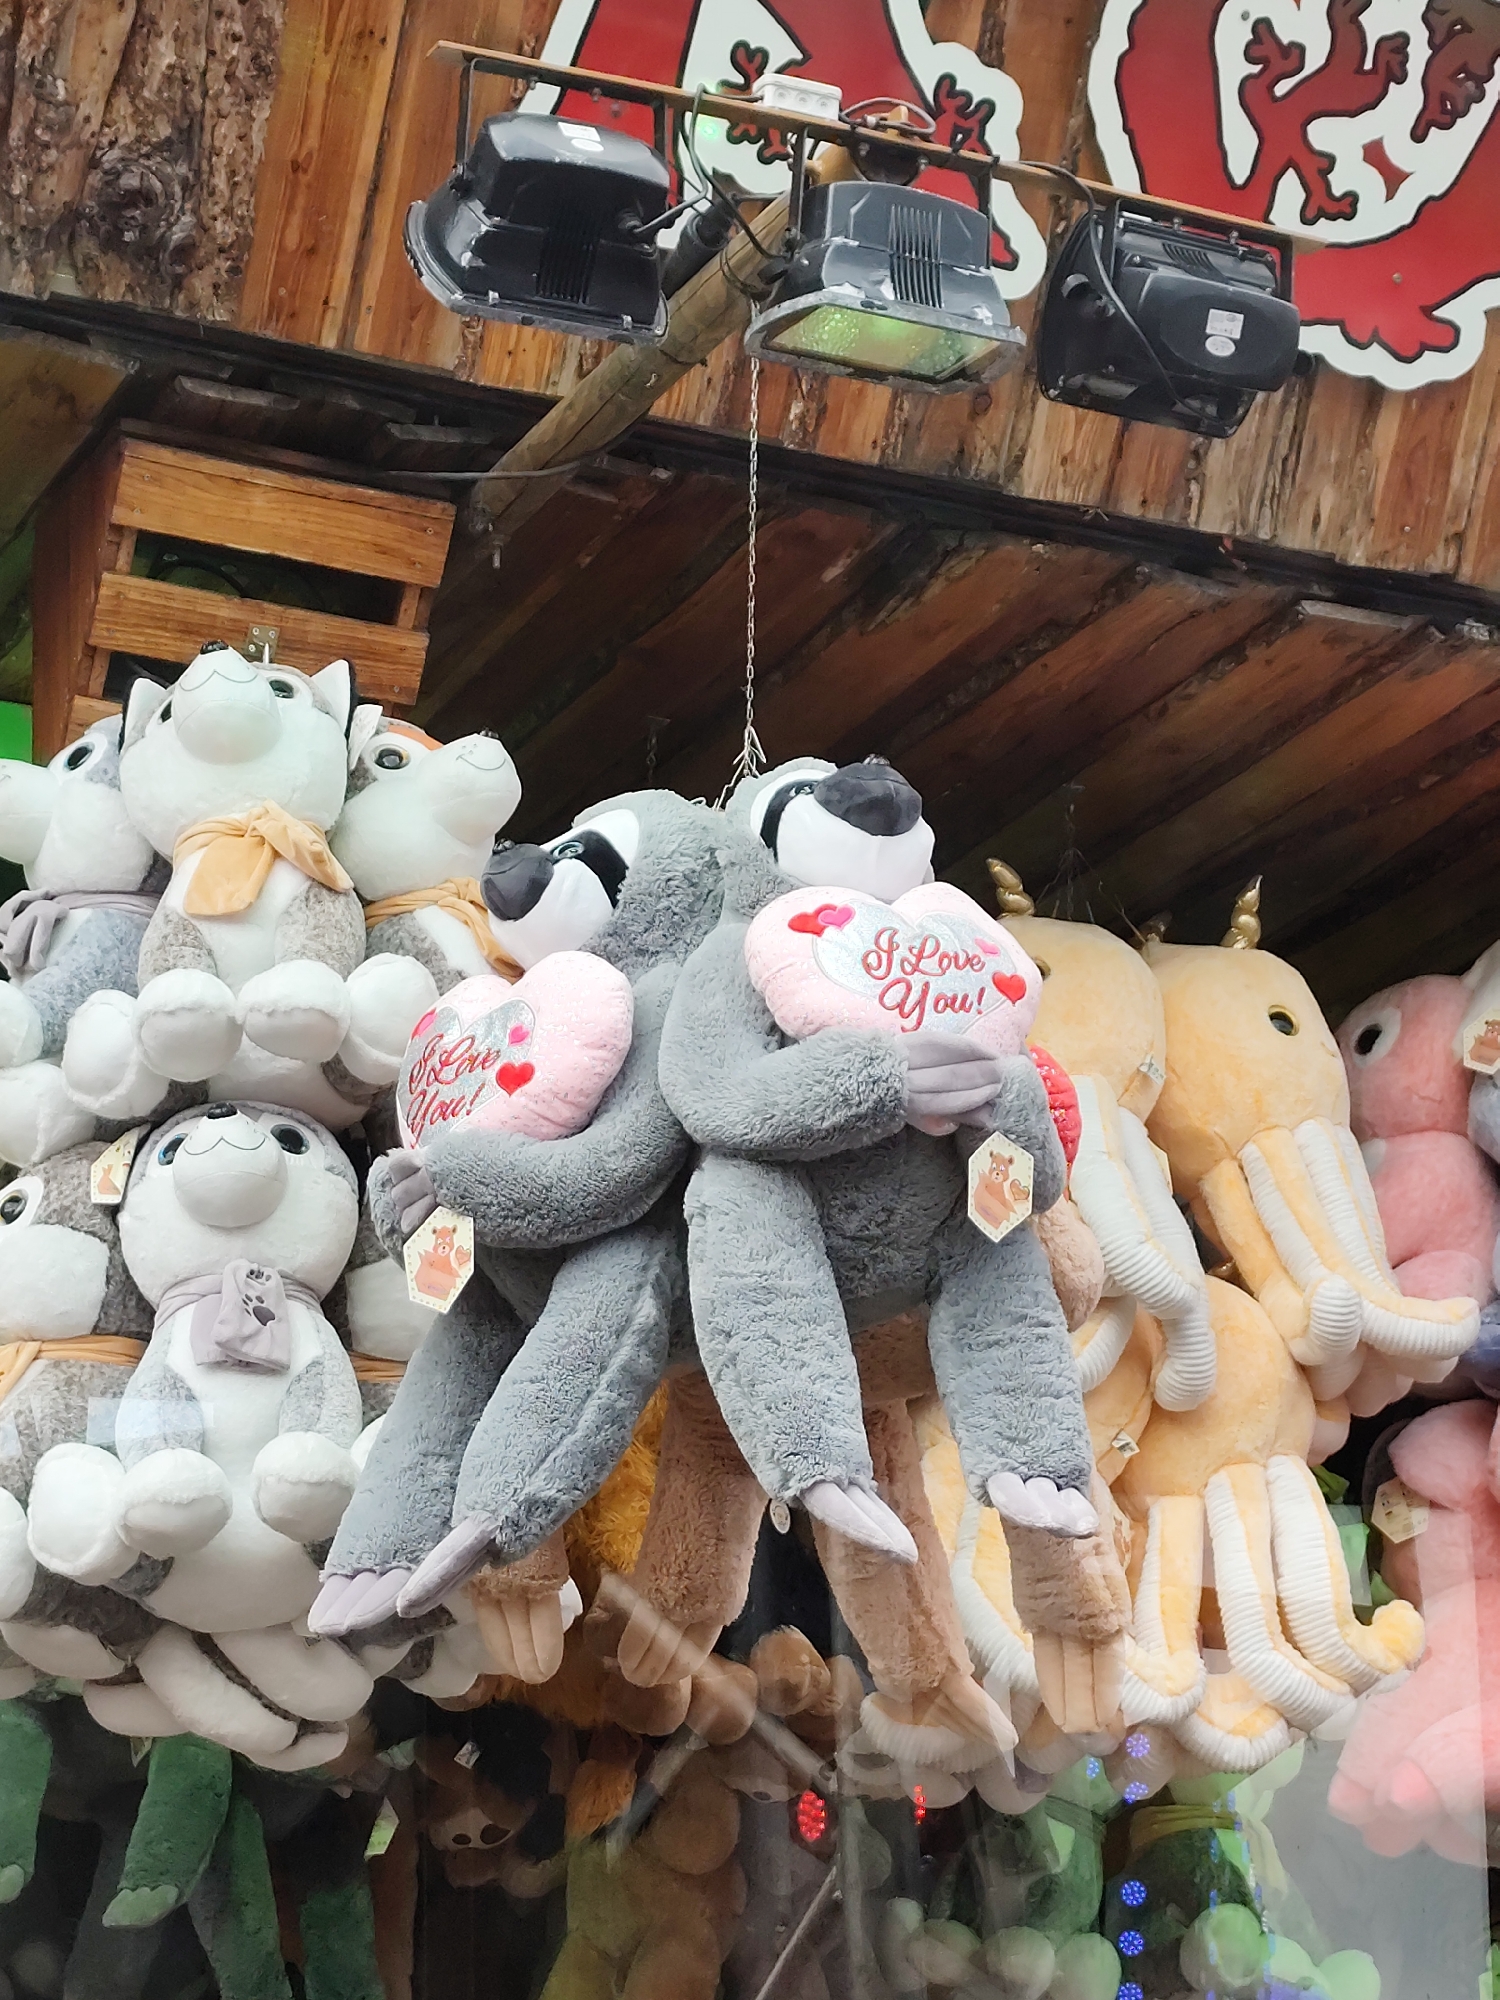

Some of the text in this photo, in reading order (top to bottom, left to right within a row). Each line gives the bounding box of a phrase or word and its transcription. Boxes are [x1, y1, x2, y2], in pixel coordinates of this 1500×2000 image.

[862, 926, 986, 980] I Love
[878, 977, 986, 1033] You!
[426, 1034, 500, 1087] Love
[406, 1082, 485, 1149] You!
